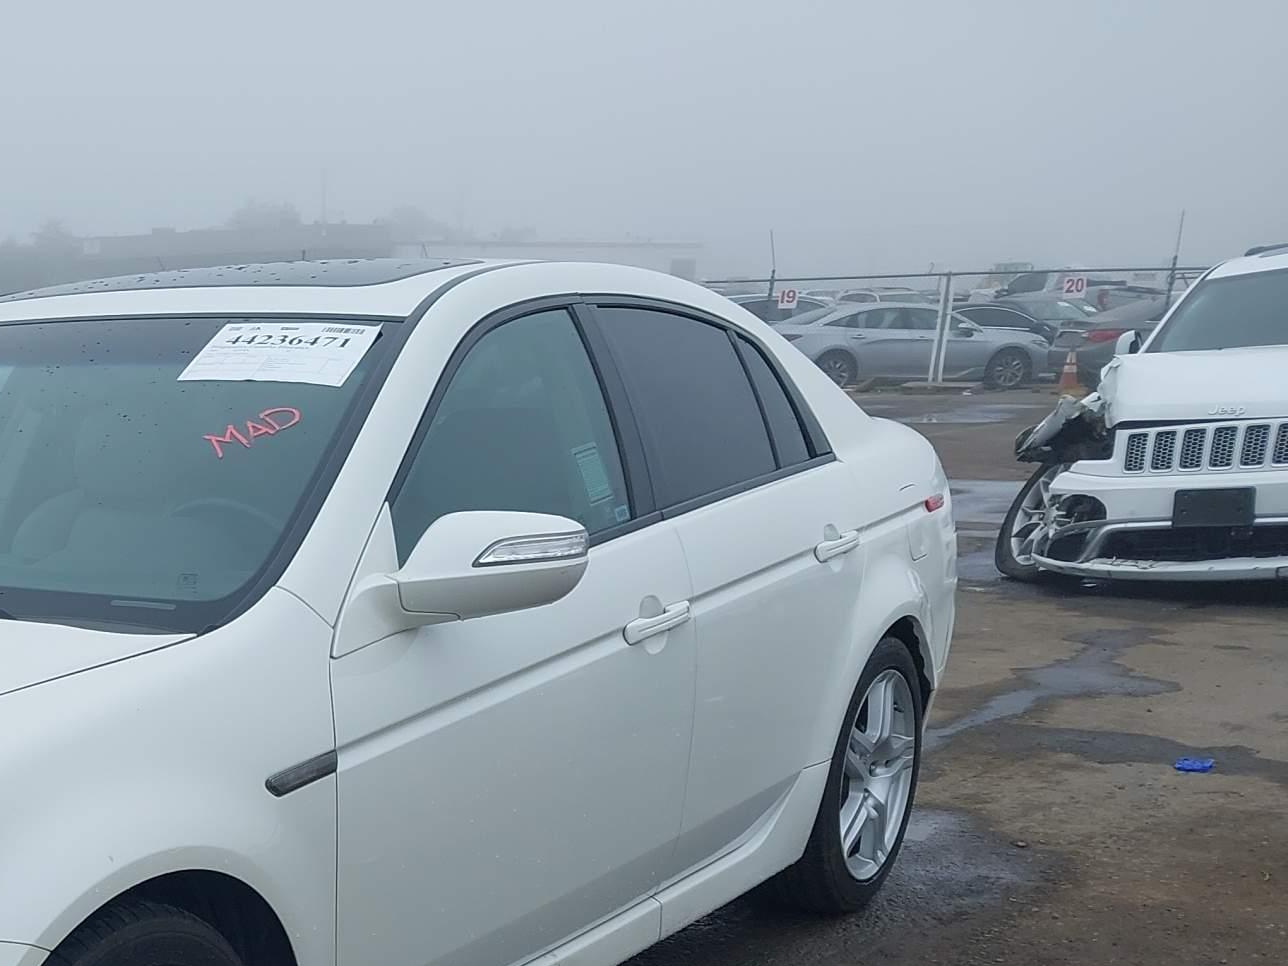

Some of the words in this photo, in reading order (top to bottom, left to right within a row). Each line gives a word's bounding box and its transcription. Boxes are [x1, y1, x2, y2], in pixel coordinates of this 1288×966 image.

[1064, 278, 1084, 293] 20
[780, 289, 797, 304] 19
[225, 334, 352, 348] 44236471
[1207, 404, 1247, 417] Jeep
[202, 406, 302, 459] MAD
